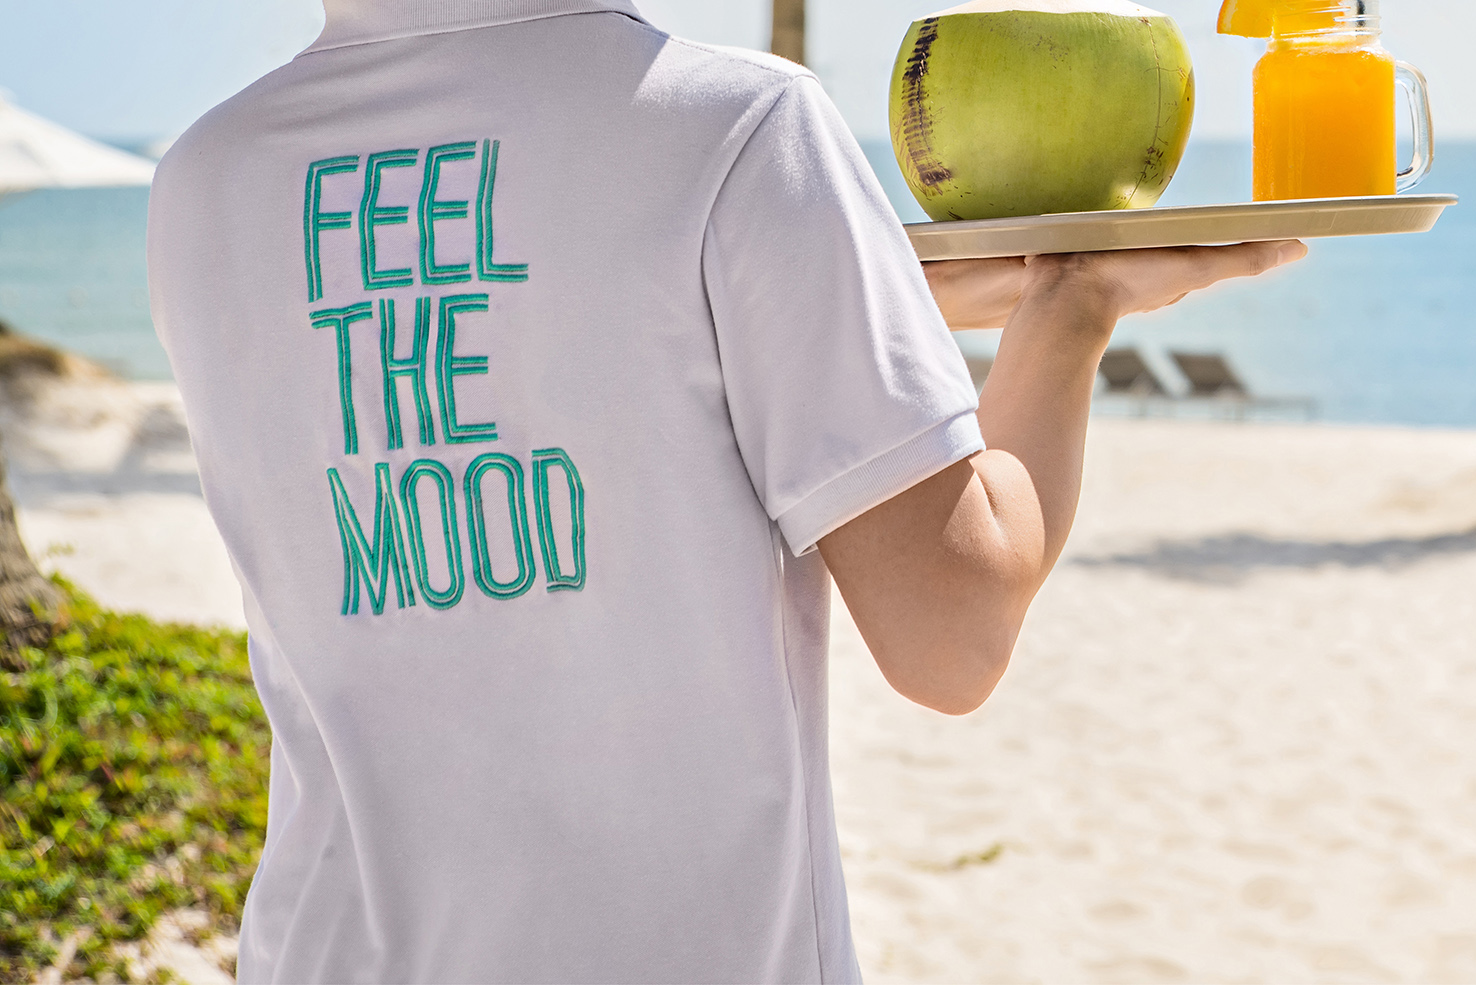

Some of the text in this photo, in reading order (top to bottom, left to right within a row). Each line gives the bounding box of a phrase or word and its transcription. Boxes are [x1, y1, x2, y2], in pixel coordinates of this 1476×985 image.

[303, 138, 529, 303] FEEL
[309, 293, 498, 455] THE
[326, 447, 586, 616] MOOD
